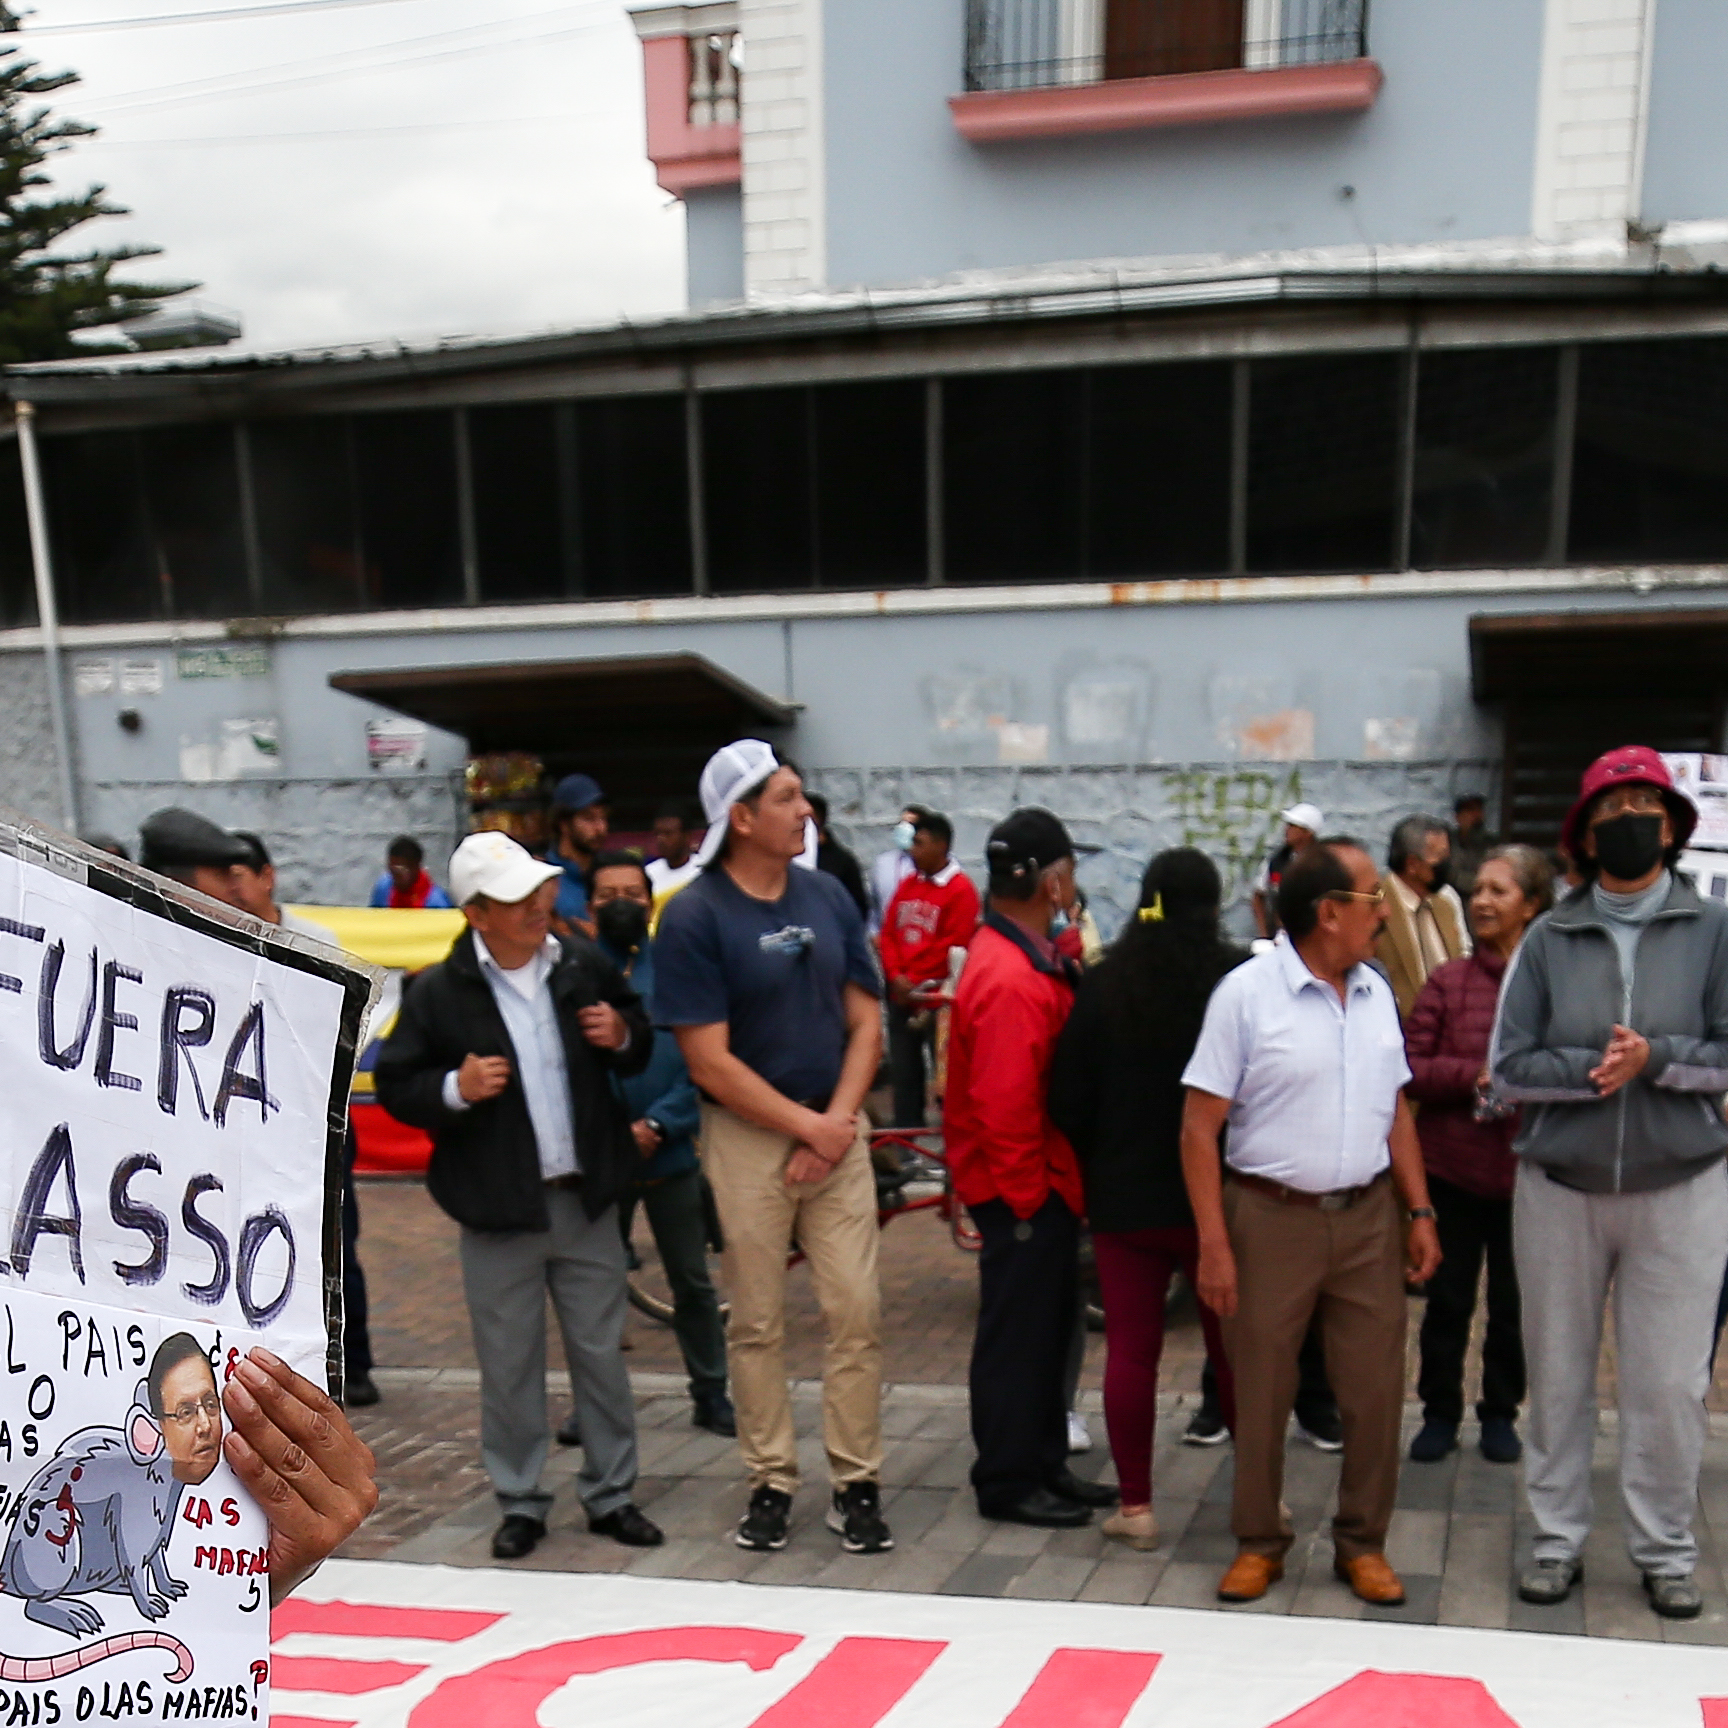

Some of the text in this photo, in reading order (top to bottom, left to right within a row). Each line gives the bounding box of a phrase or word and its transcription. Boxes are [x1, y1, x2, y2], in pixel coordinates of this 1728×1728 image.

[57, 1310, 146, 1378] PAIS
[28, 1373, 56, 1420] O
[182, 1496, 241, 1529] LAS
